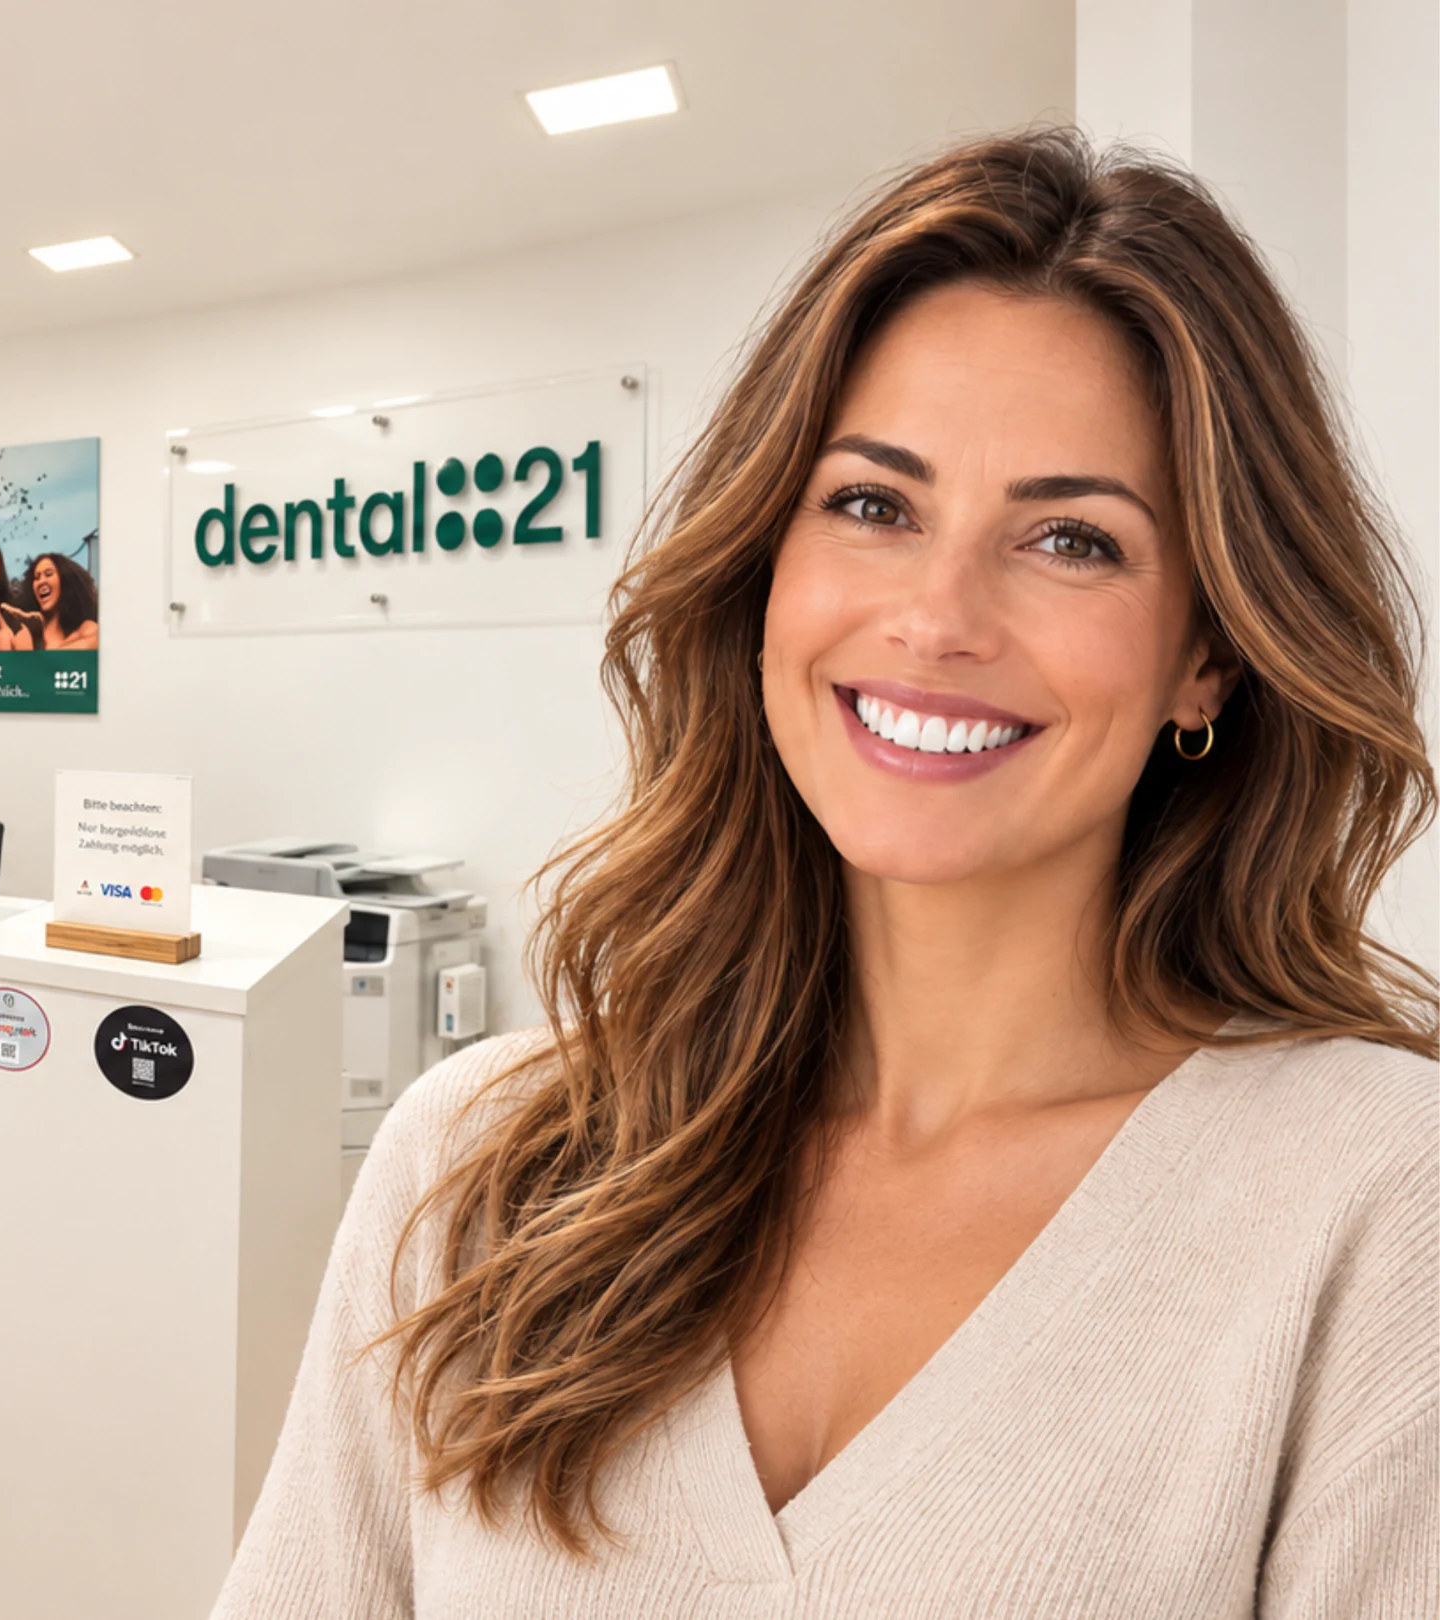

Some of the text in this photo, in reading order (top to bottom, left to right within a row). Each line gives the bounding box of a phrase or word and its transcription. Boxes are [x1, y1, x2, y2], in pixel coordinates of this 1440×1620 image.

[194, 440, 602, 568] dental 21
[69, 671, 87, 689] 21
[100, 883, 132, 899] VISA
[130, 1037, 178, 1057] TikTok
